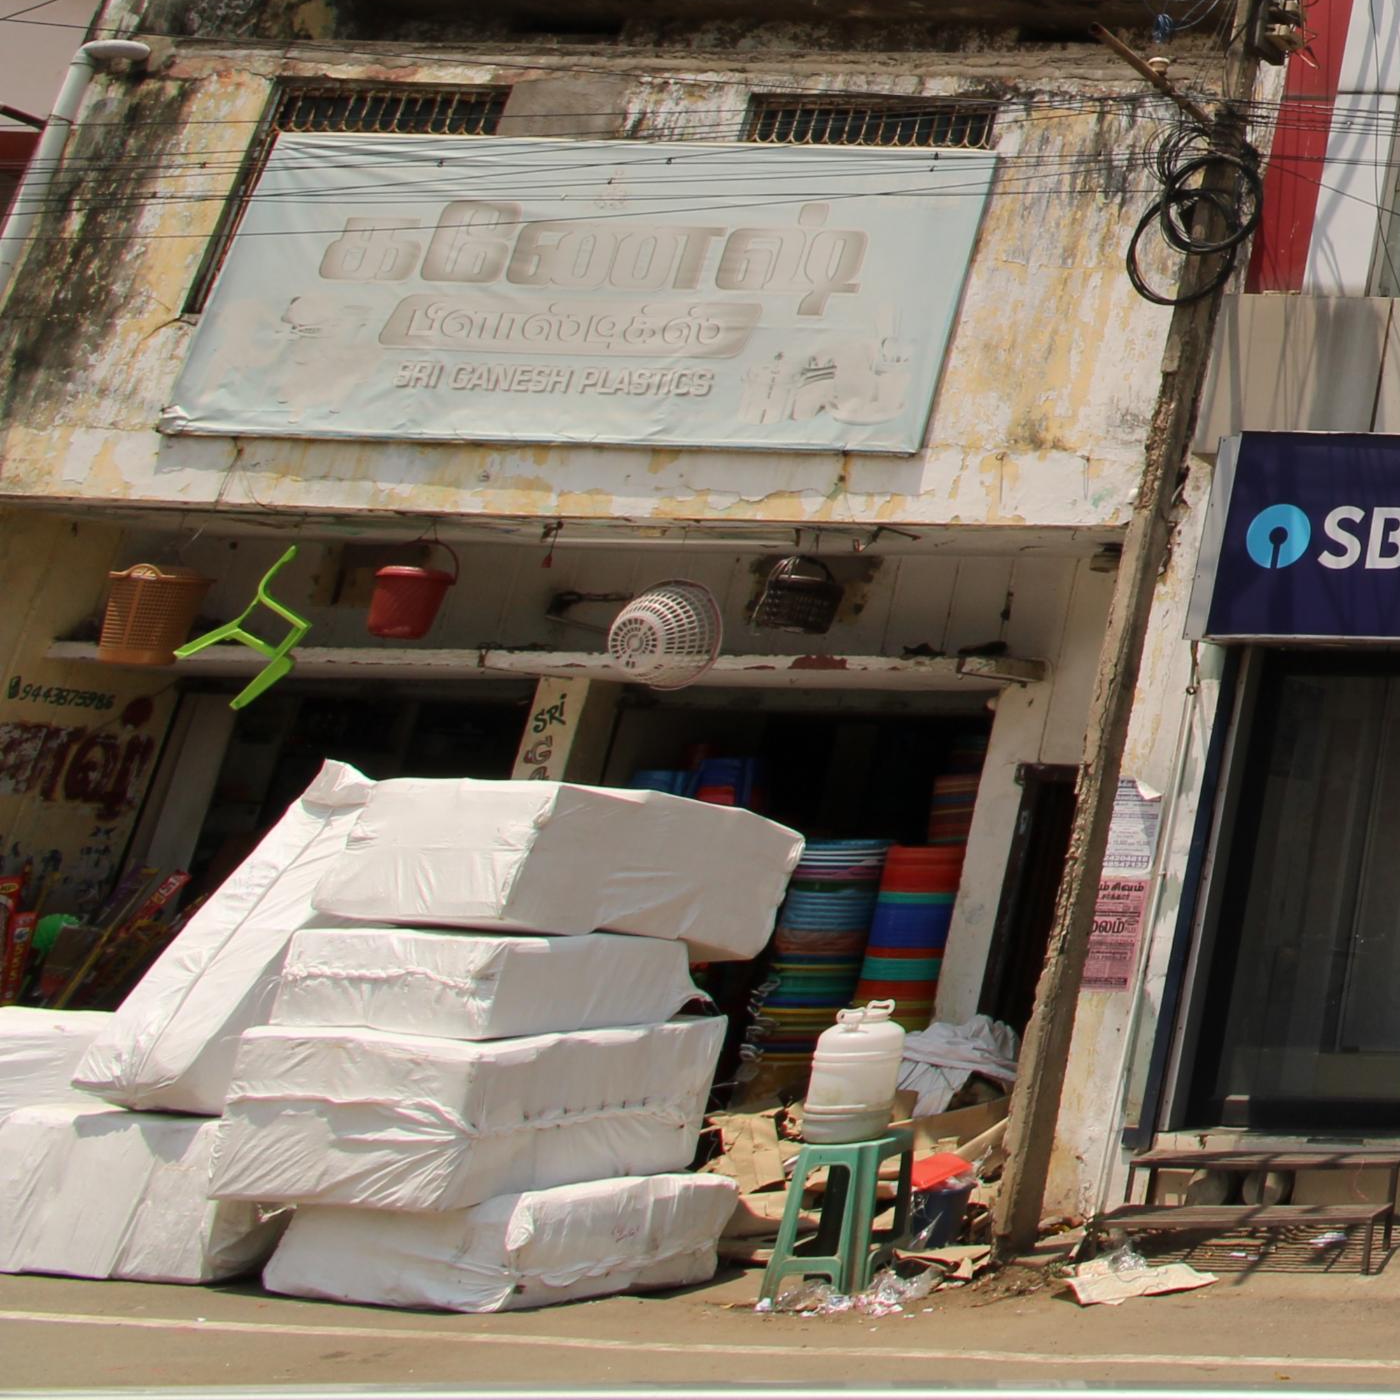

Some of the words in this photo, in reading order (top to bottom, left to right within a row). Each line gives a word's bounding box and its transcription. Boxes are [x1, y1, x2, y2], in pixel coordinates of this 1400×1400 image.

[393, 359, 444, 390] SRI
[447, 363, 574, 394] GANESH
[579, 367, 715, 397] PLASTICS
